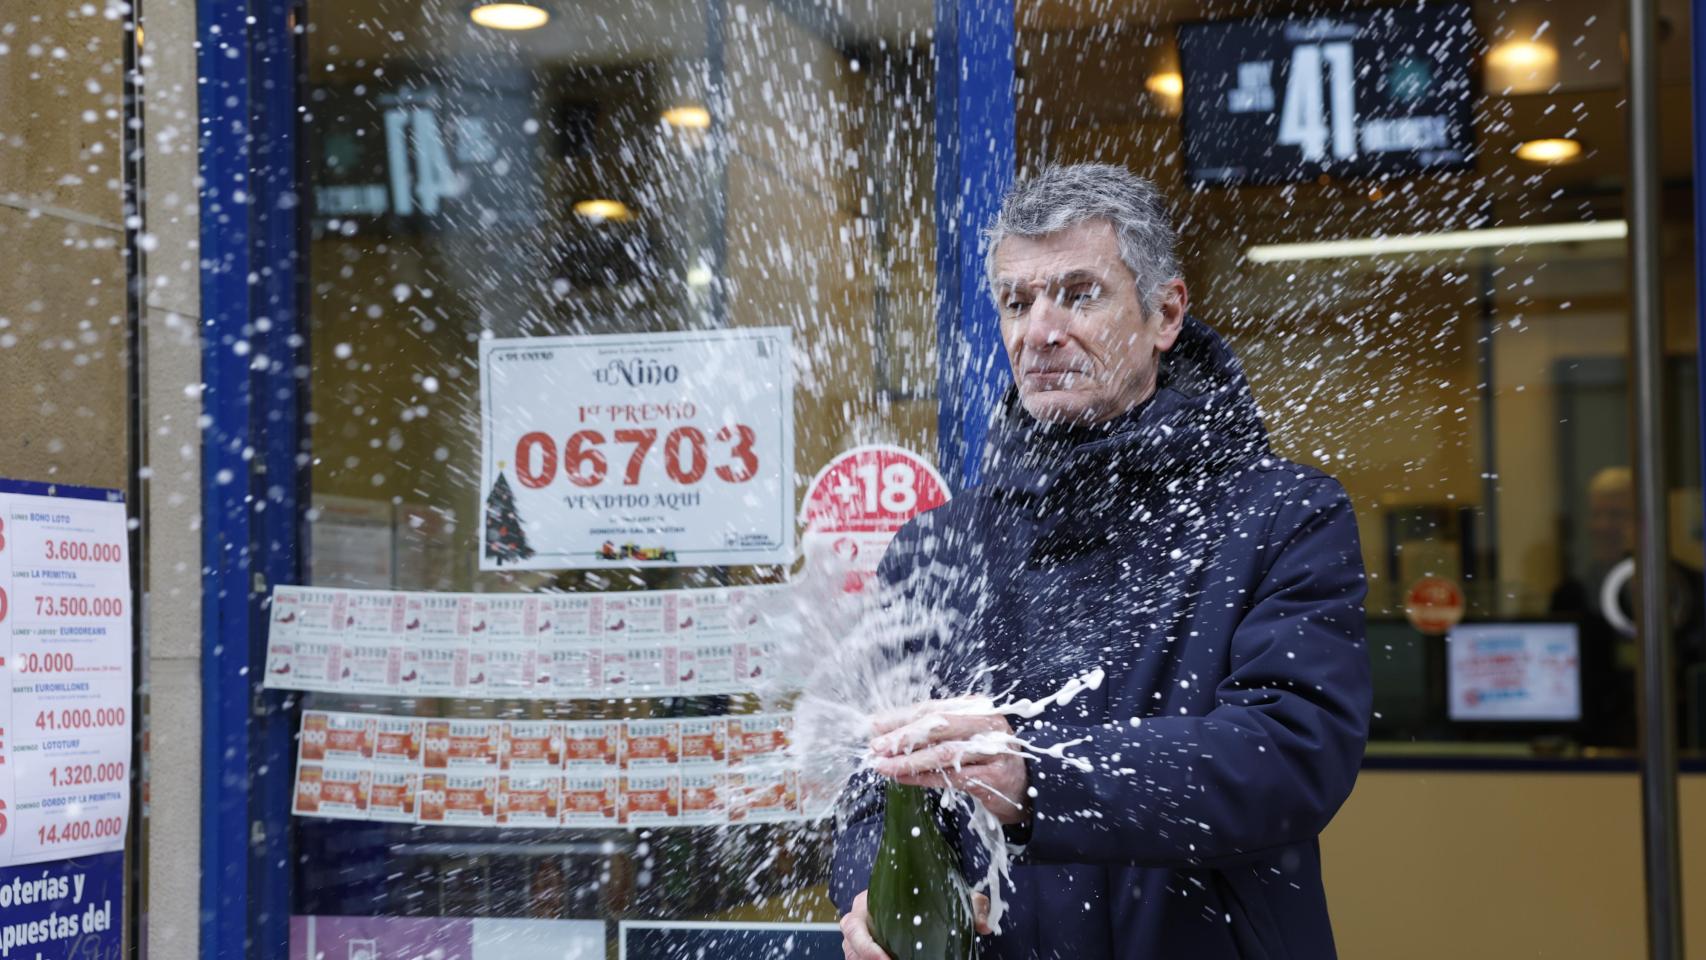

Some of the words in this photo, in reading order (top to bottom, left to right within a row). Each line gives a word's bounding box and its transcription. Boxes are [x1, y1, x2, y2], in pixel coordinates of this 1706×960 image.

[1277, 42, 1357, 160] 41
[606, 402, 696, 424] PREMIO
[515, 424, 759, 489] 06703
[833, 463, 917, 513] +18
[563, 494, 650, 510] VENDIDO
[30, 513, 50, 523] BONO
[52, 515, 70, 524] LOTO
[45, 540, 121, 562] 3.600.000
[31, 570, 40, 579] LA
[42, 570, 77, 580] PRIMITIVA
[35, 596, 122, 616] 73.500.000
[35, 682, 90, 693] EUROMILLONES
[35, 708, 125, 730] 41.000.000
[42, 739, 80, 750] LOTOTURF
[49, 762, 124, 786] 1.320.000
[42, 797, 66, 808] GORDO
[89, 792, 121, 802] PRIMITIVA
[38, 816, 122, 845] 14.400.000
[73, 873, 85, 904] y
[0, 911, 79, 957] puestas
[82, 900, 111, 934] del
